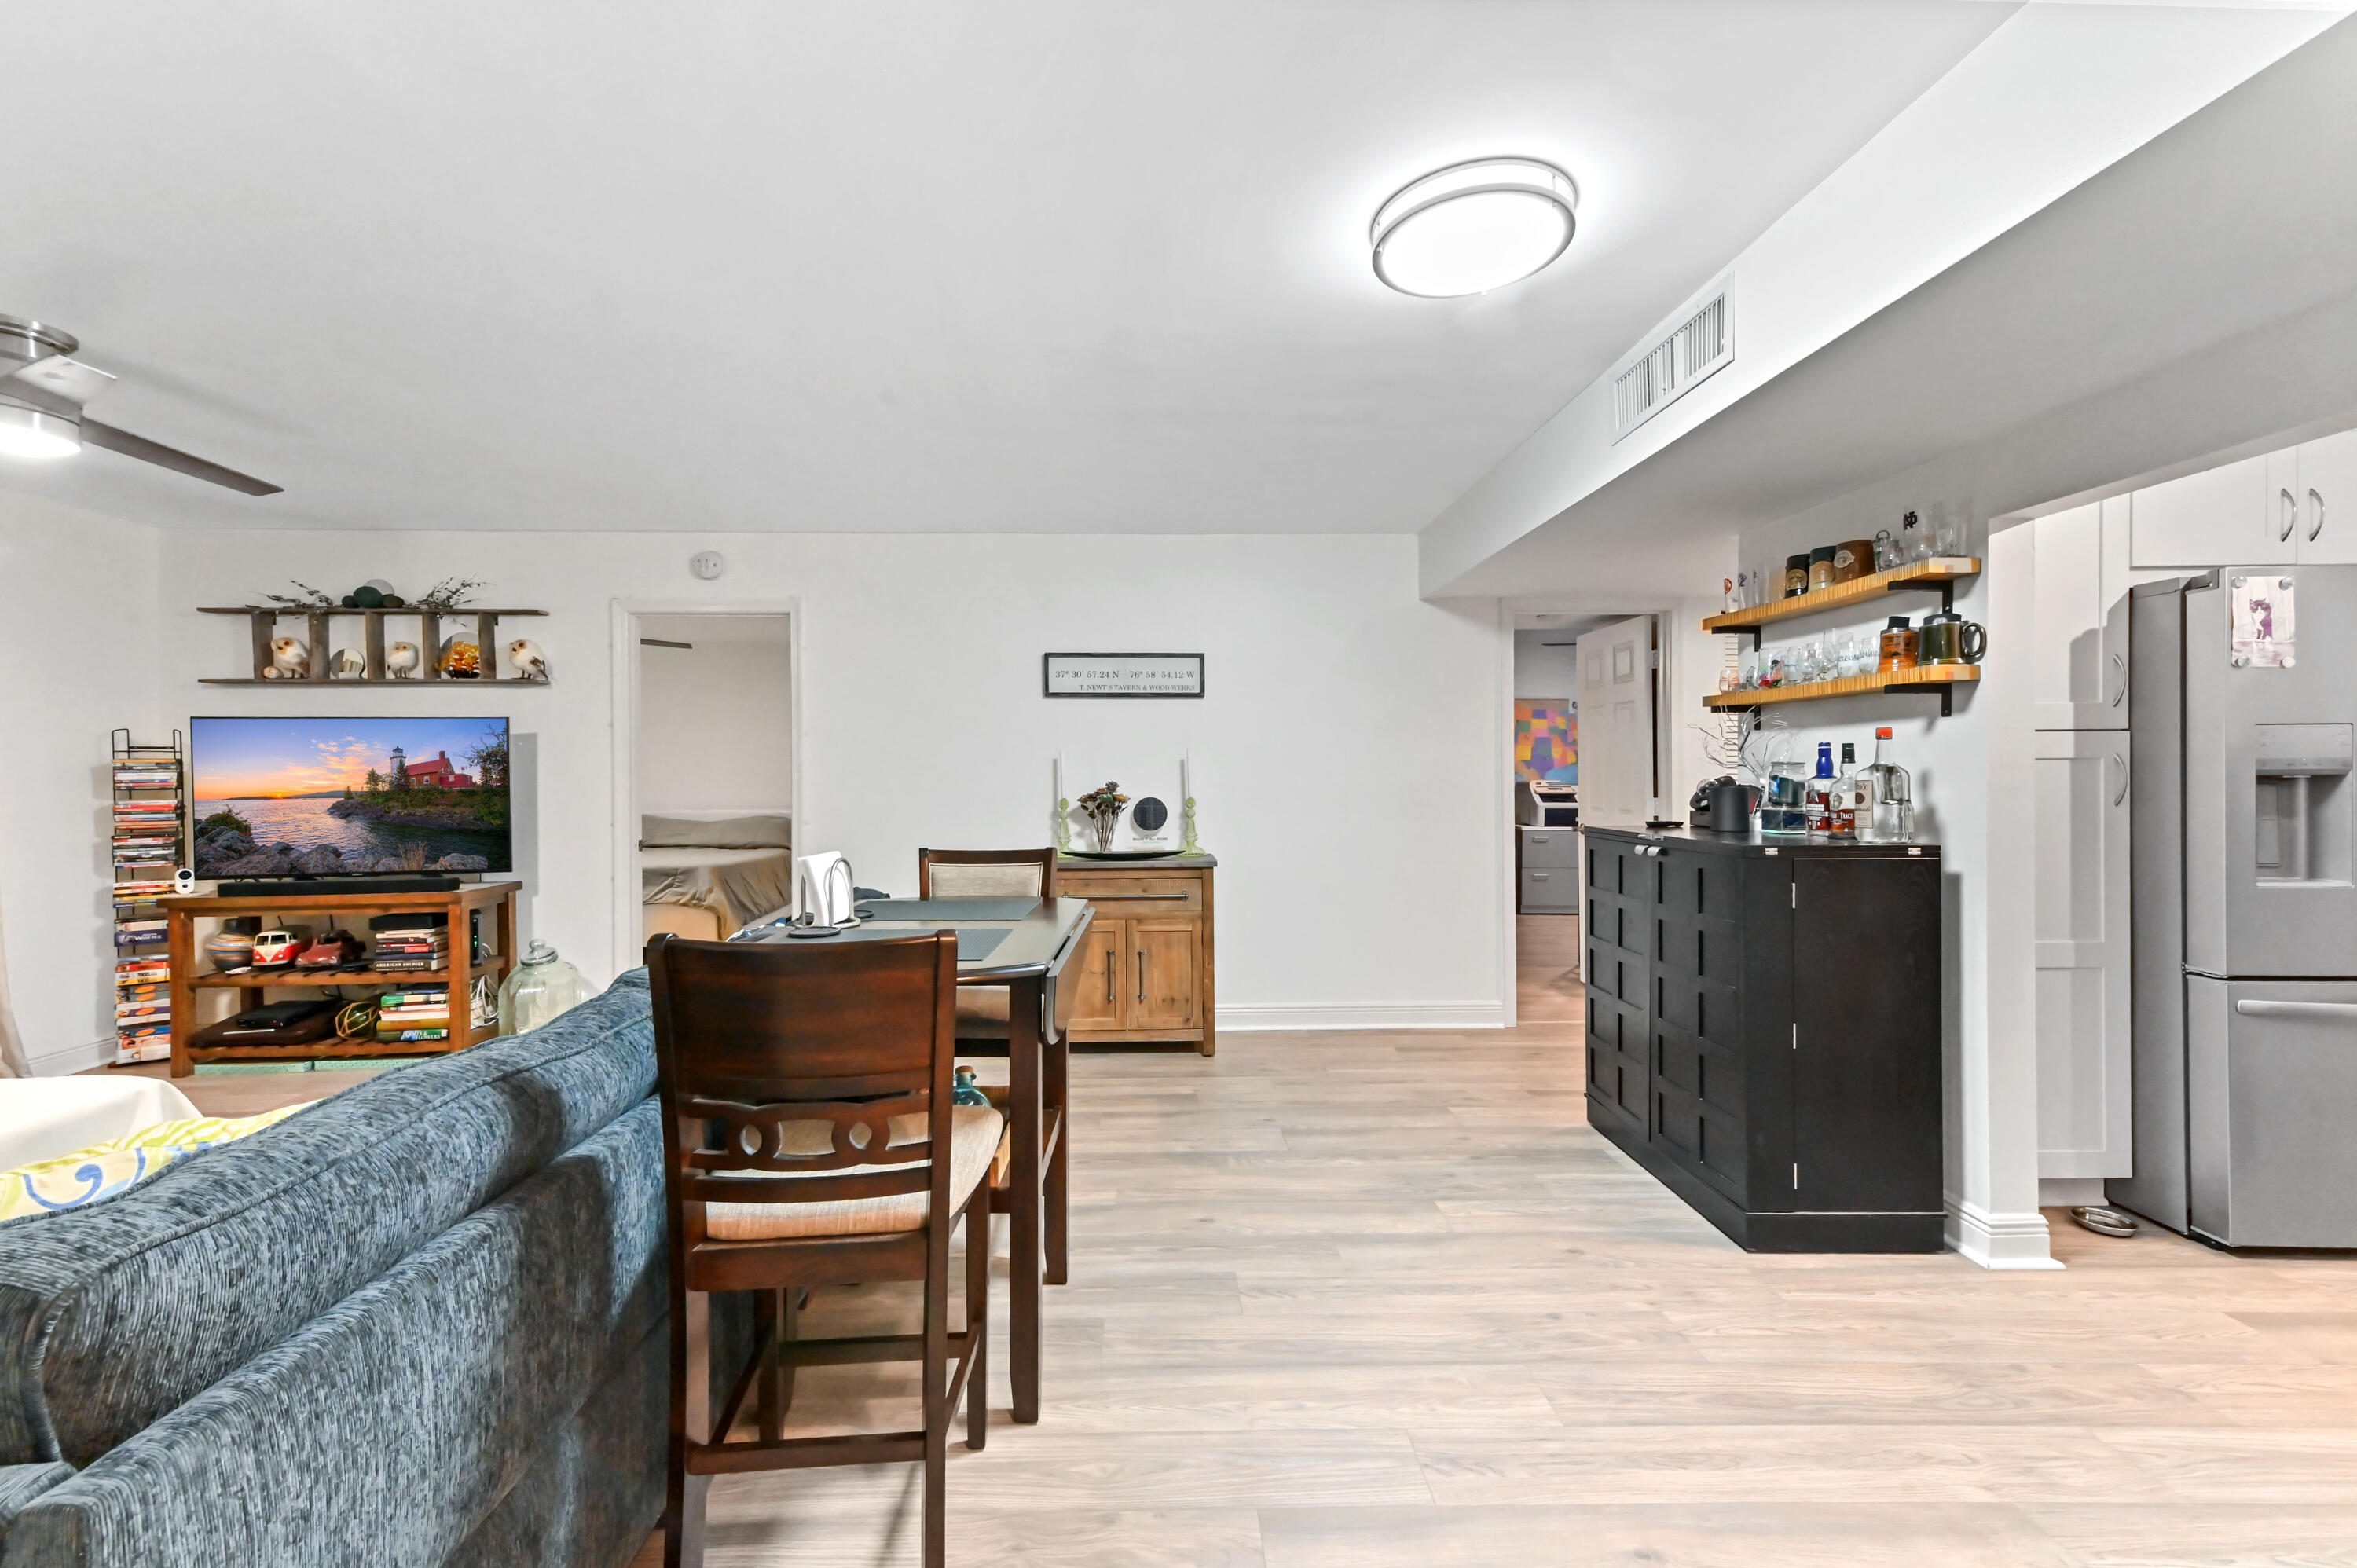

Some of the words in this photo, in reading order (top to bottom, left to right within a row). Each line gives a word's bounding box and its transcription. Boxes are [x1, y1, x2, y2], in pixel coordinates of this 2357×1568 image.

[1055, 670, 1069, 679] 37°
[1087, 670, 1109, 679] 57.24
[1112, 670, 1120, 679] N
[1130, 670, 1143, 679] 76°
[1161, 670, 1184, 679] 54.12
